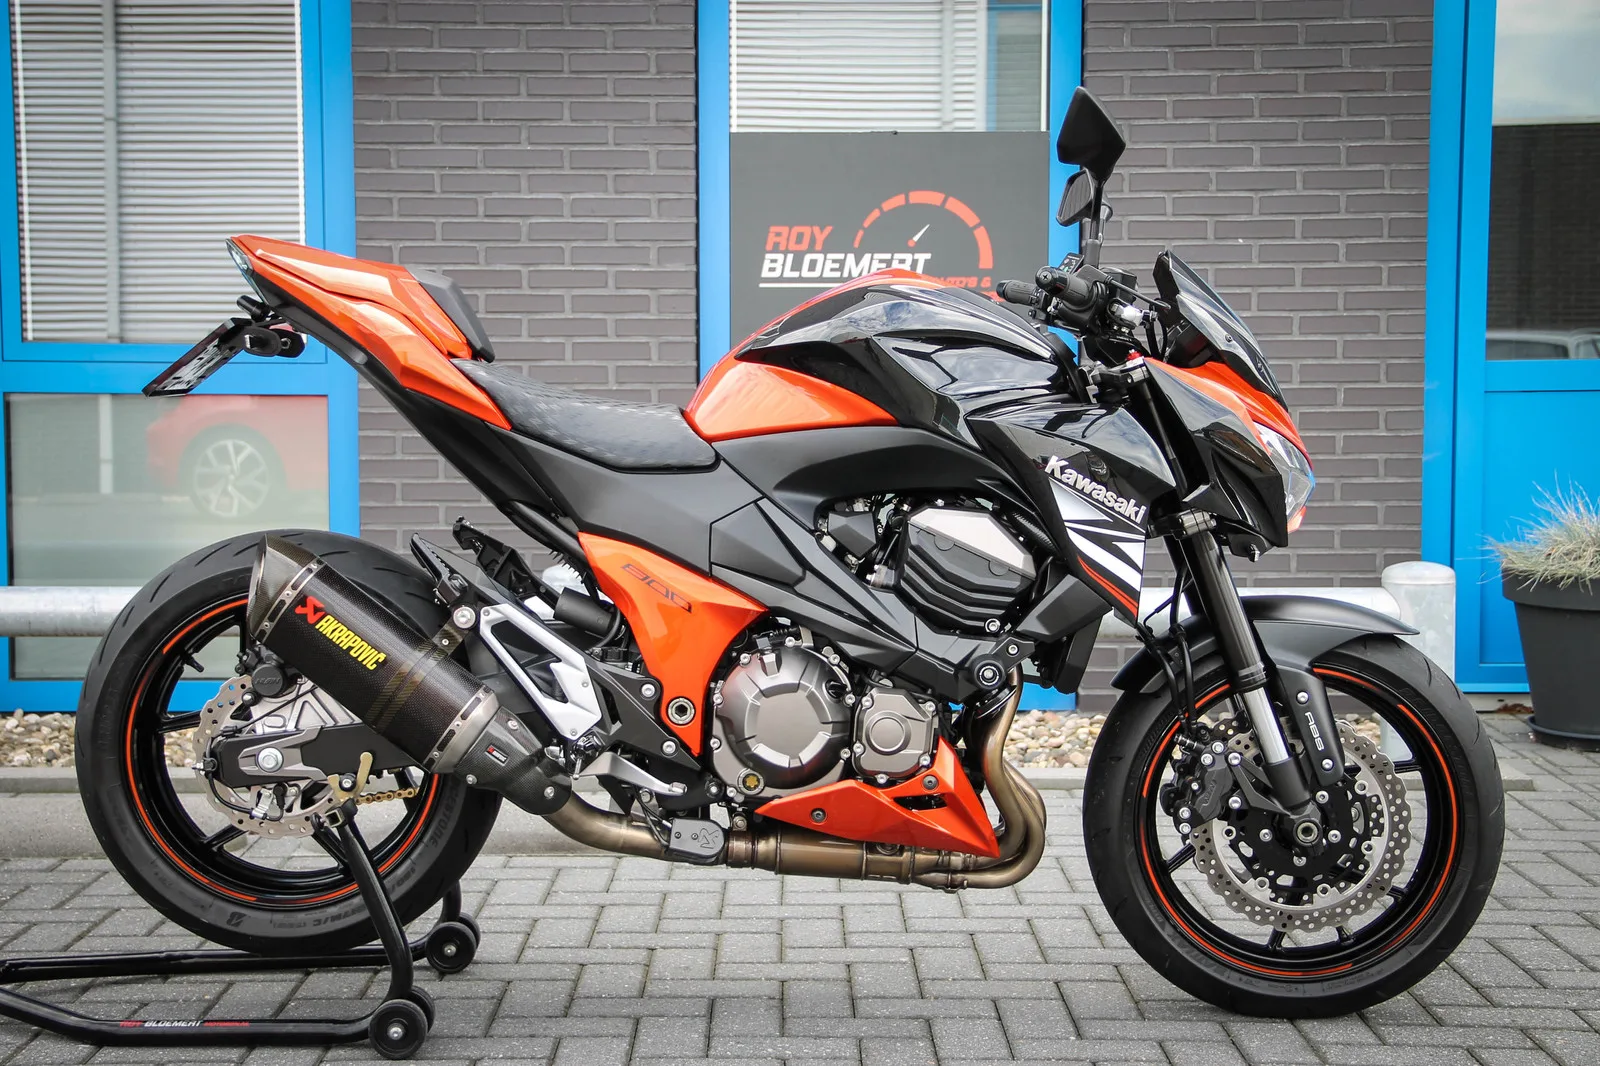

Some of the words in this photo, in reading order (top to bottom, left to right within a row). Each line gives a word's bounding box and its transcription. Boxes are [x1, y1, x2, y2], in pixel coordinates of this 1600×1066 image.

[765, 225, 834, 251] ROY
[760, 253, 932, 278] BLOEMERT
[1044, 455, 1147, 524] Kawasaki
[621, 563, 693, 614] 800
[1304, 711, 1325, 751] ABS
